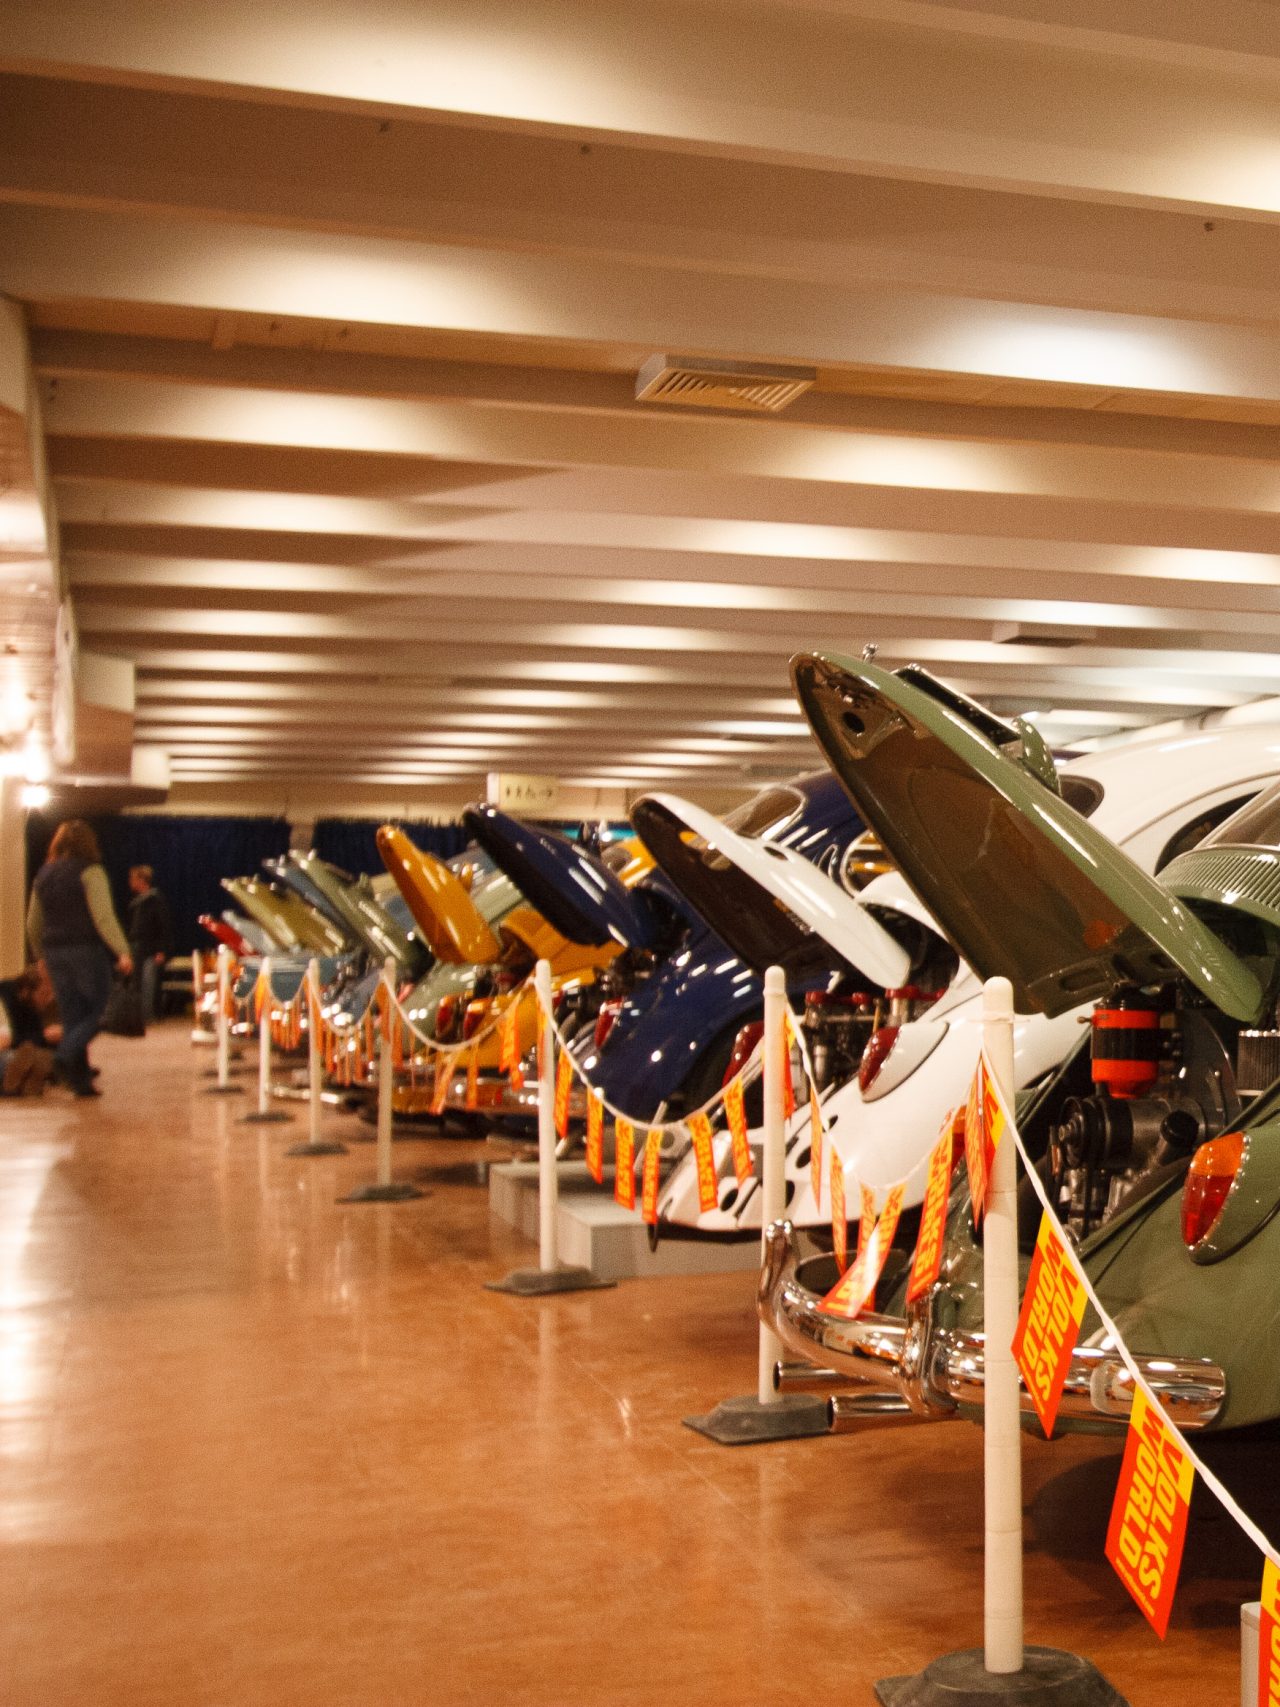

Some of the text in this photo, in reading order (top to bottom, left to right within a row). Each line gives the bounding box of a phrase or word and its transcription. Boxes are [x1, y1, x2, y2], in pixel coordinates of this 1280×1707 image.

[1022, 1229, 1065, 1371] WORLD
[1035, 1264, 1080, 1402] VOLKS
[1119, 1404, 1165, 1569] WORLD
[1138, 1438, 1184, 1600] VOLKS
